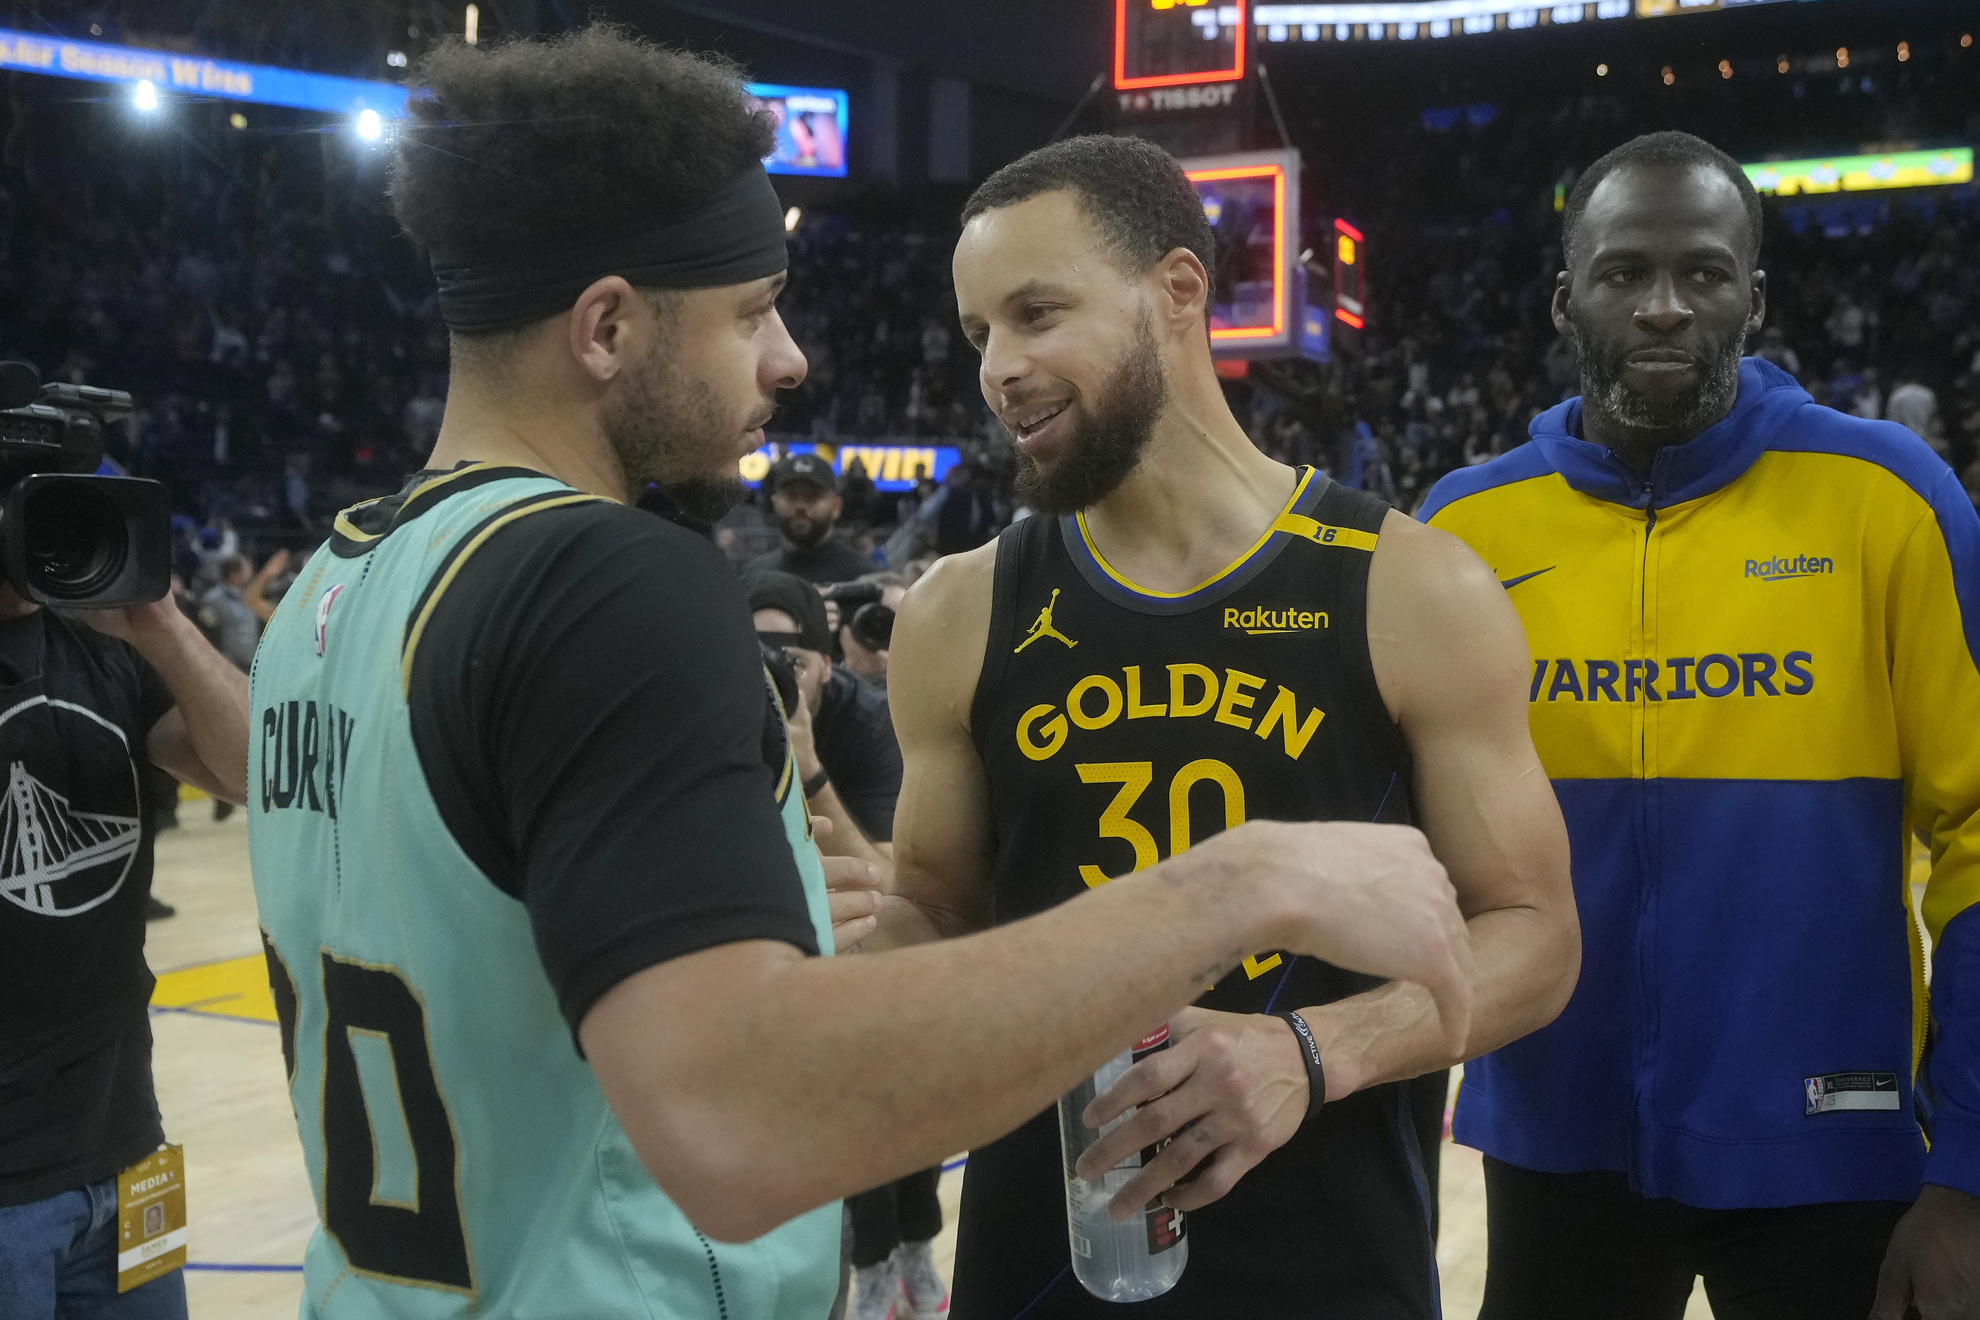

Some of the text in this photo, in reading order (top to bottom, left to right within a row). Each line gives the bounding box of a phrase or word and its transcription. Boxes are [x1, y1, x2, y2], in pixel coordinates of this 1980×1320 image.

[1151, 84, 1237, 111] TISSOT
[1313, 526, 1338, 543] 16
[1744, 553, 1834, 582] Rakuten
[1223, 606, 1329, 634] Rakuten
[1015, 662, 1326, 761] GOLDEN
[261, 700, 355, 821] CURRY
[1074, 758, 1246, 890] 30
[130, 1172, 168, 1197] MEDIA
